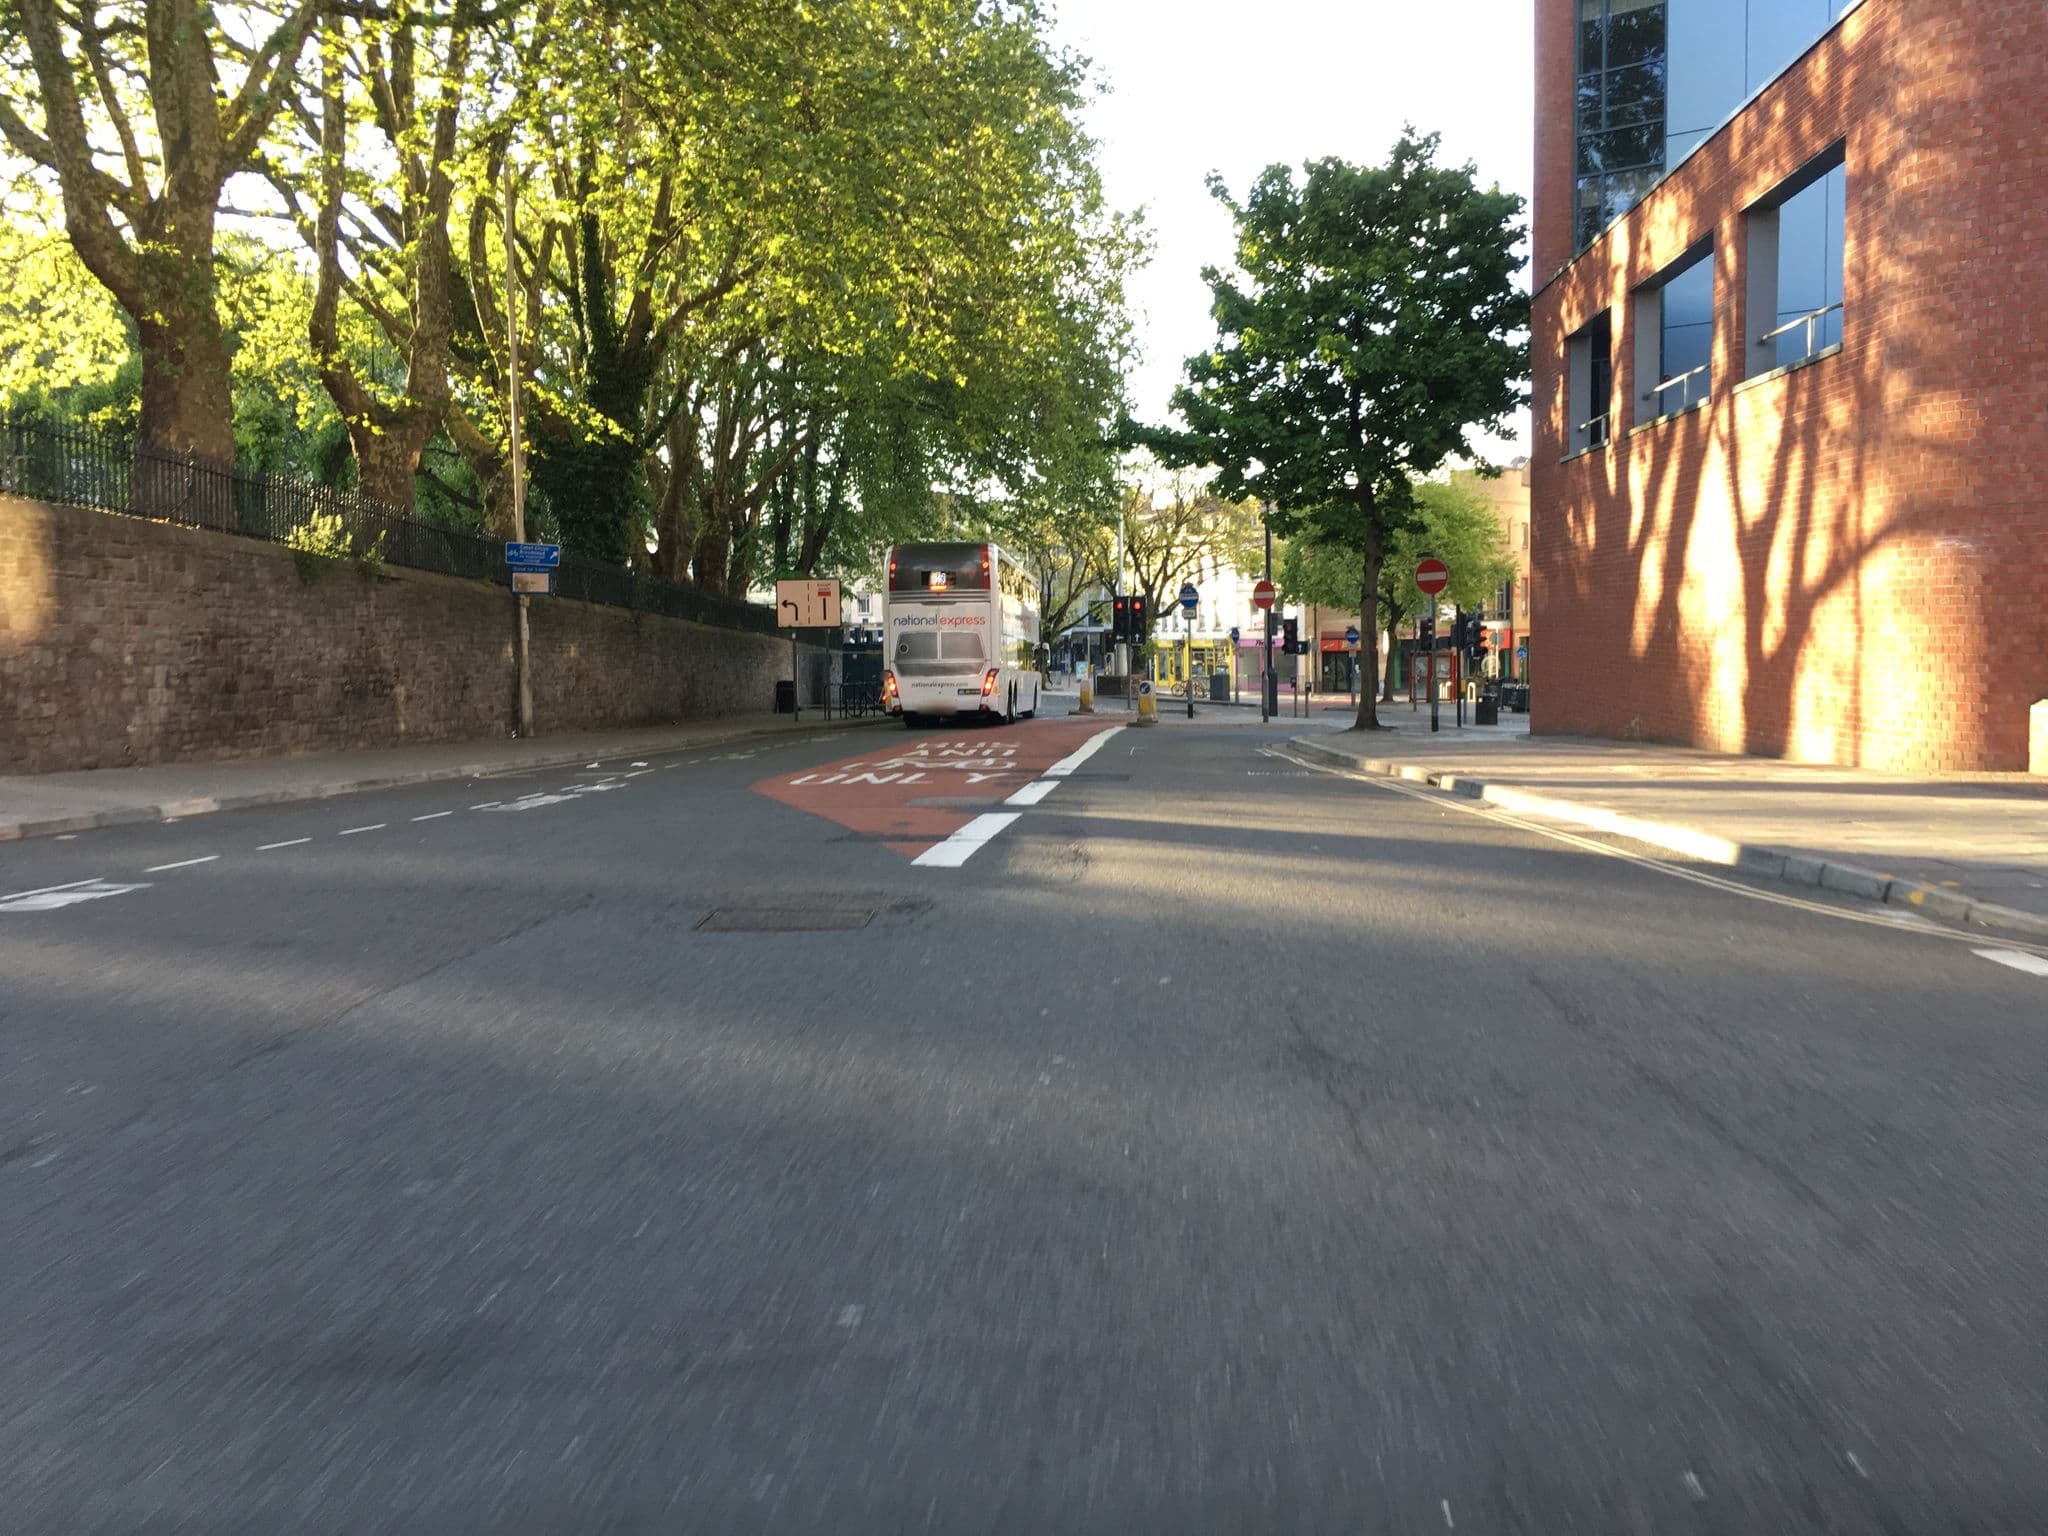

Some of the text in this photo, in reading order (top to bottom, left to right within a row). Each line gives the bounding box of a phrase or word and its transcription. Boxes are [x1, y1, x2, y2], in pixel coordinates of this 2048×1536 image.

[893, 614, 986, 628] national express
[903, 749, 1016, 757] AND
